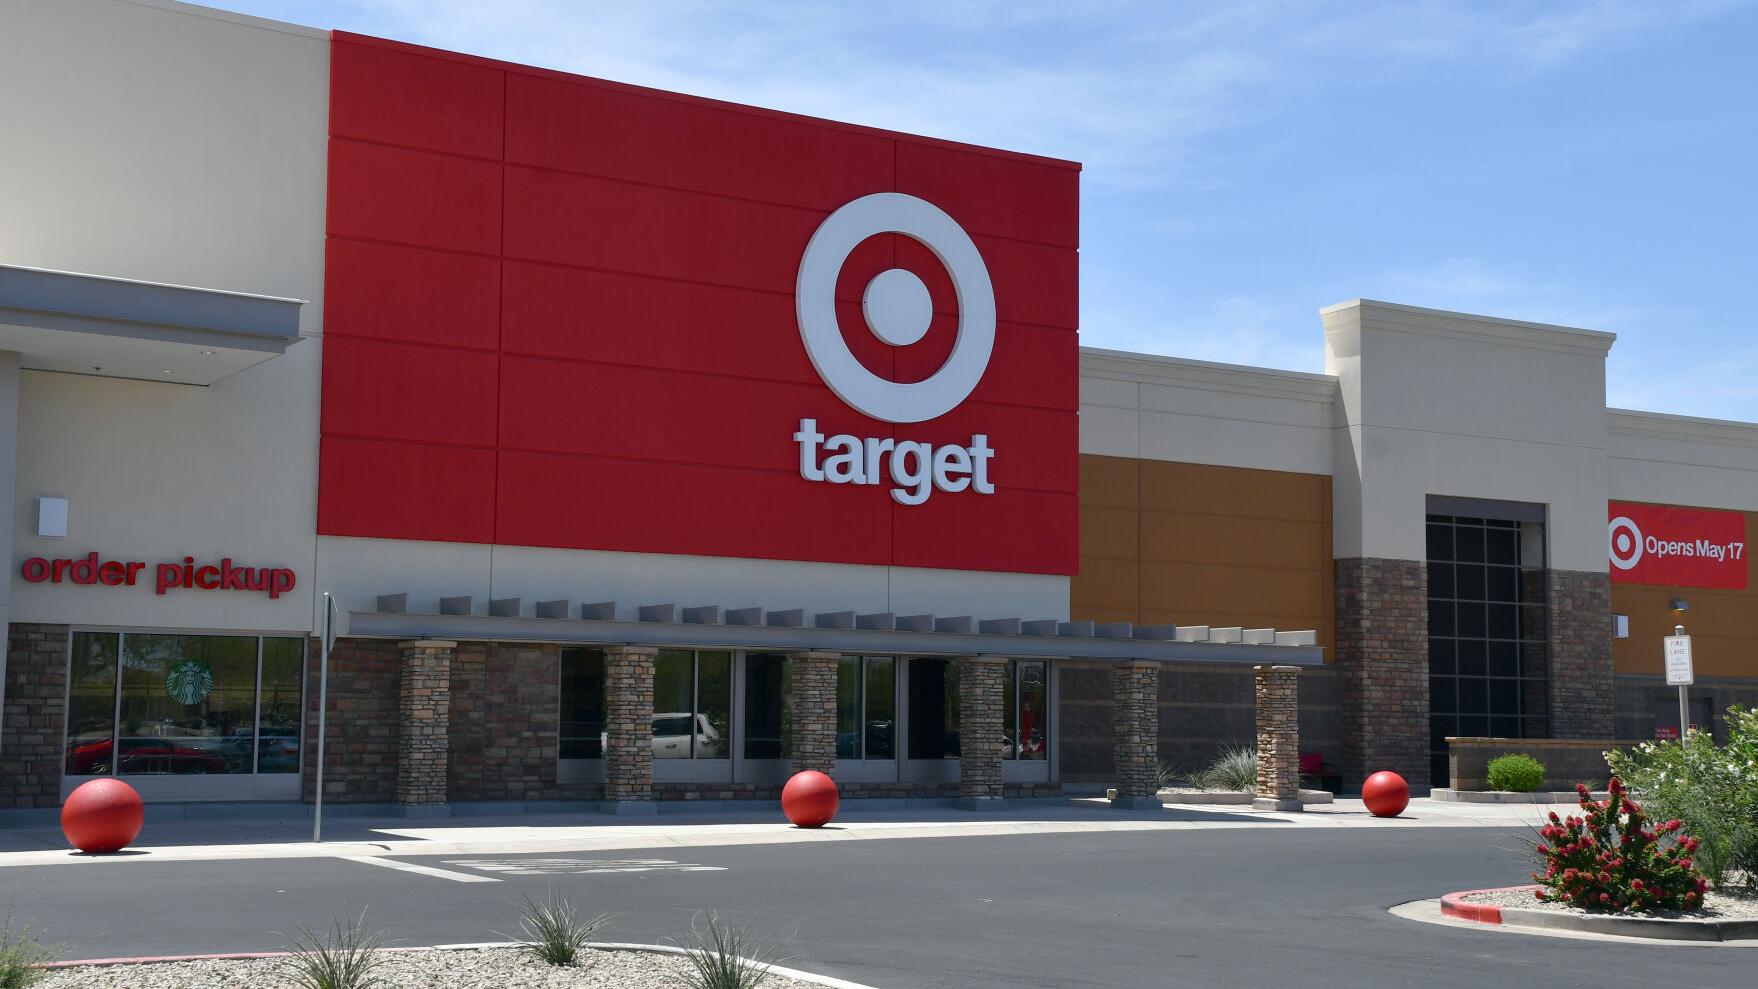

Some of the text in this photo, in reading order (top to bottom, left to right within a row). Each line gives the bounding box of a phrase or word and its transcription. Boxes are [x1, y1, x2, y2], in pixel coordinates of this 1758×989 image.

[793, 418, 994, 505] target
[1645, 535, 1744, 562] Opens May 17
[22, 552, 296, 599] order pickup
